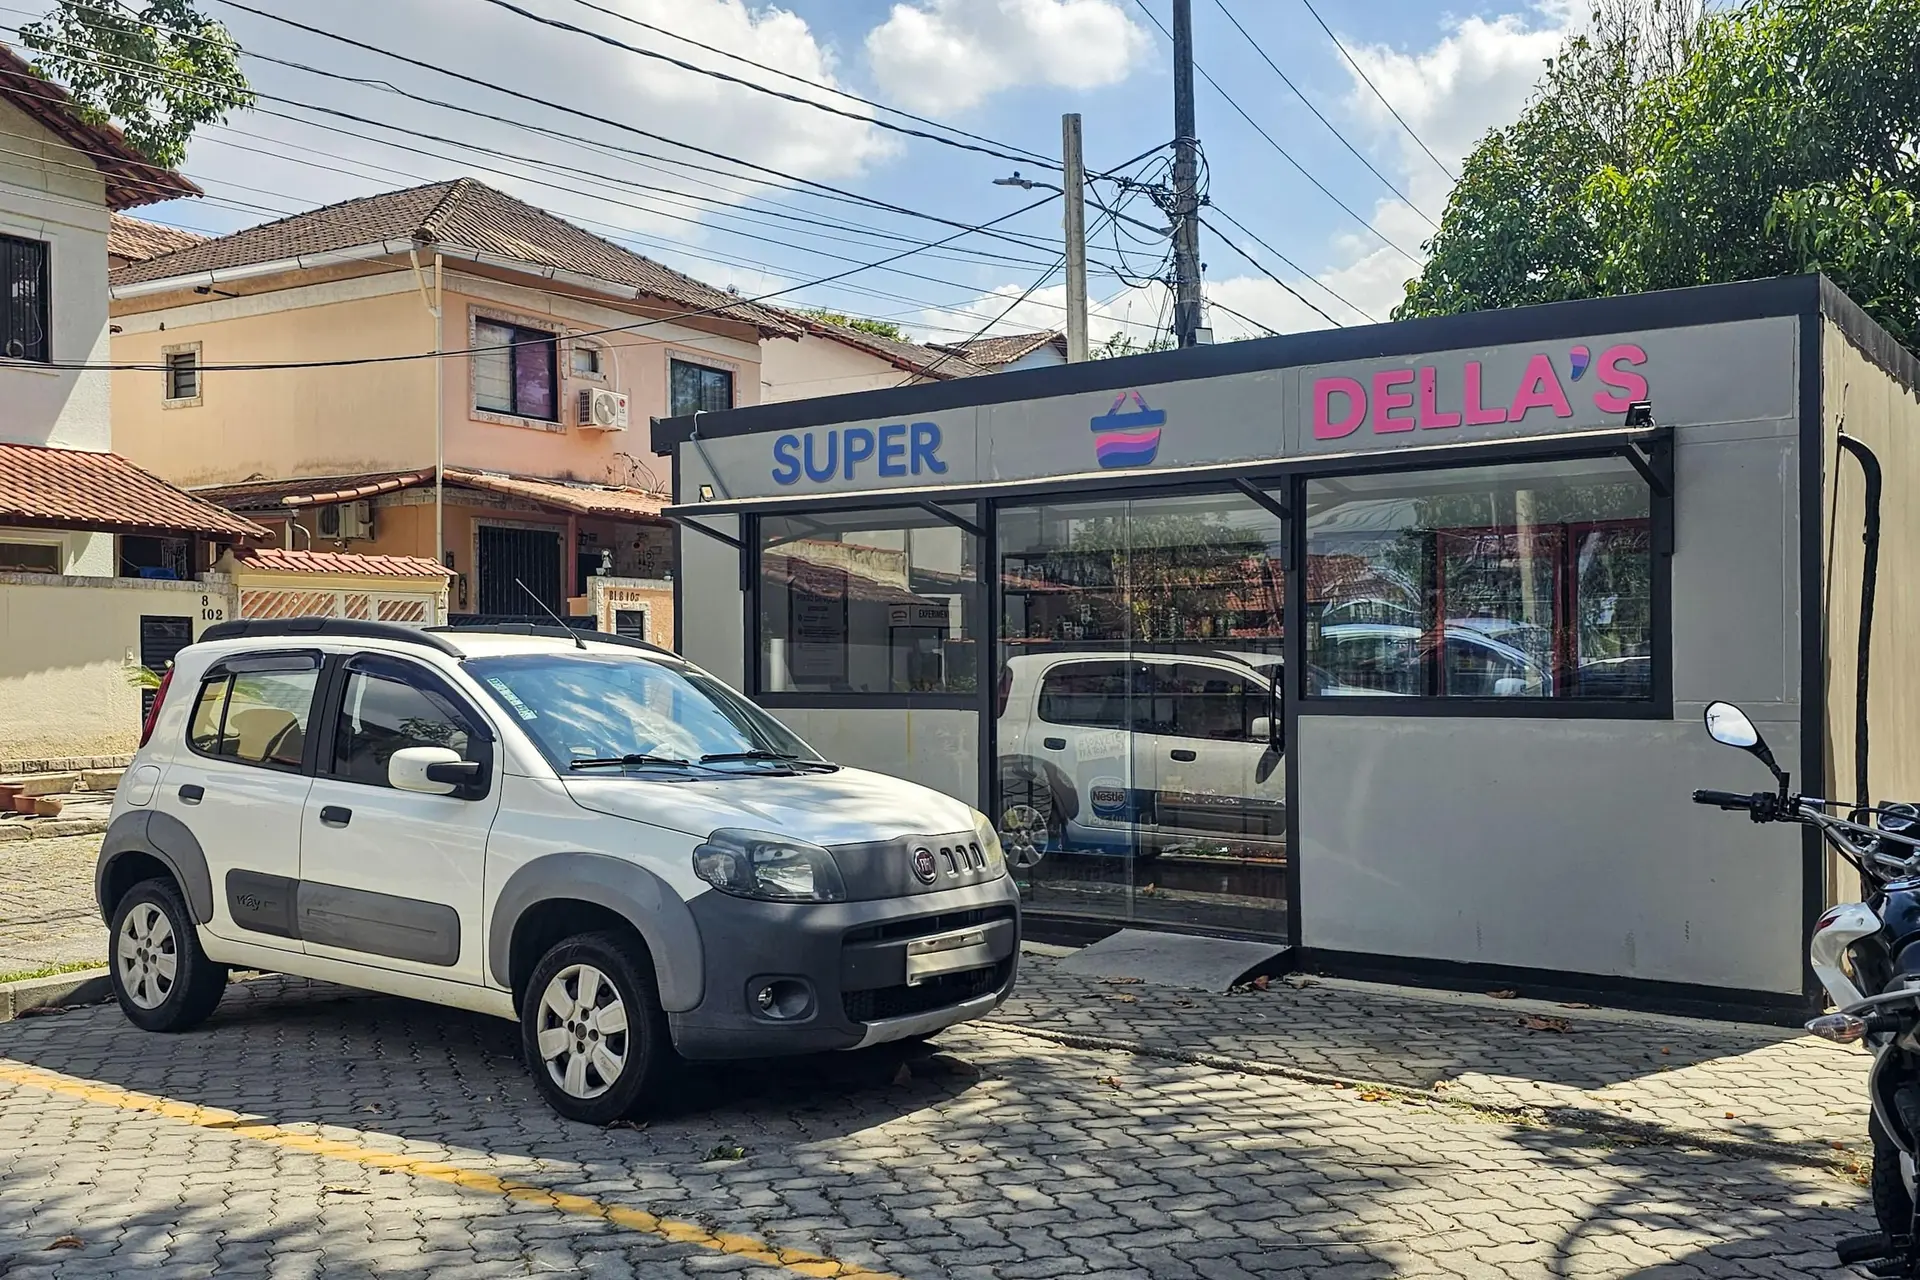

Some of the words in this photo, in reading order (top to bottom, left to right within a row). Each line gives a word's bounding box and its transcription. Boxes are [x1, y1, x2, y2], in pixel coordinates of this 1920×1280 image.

[1313, 344, 1649, 440] DELLA'S
[771, 421, 948, 485] SUPER
[202, 595, 208, 606] 8
[202, 608, 223, 620] 102
